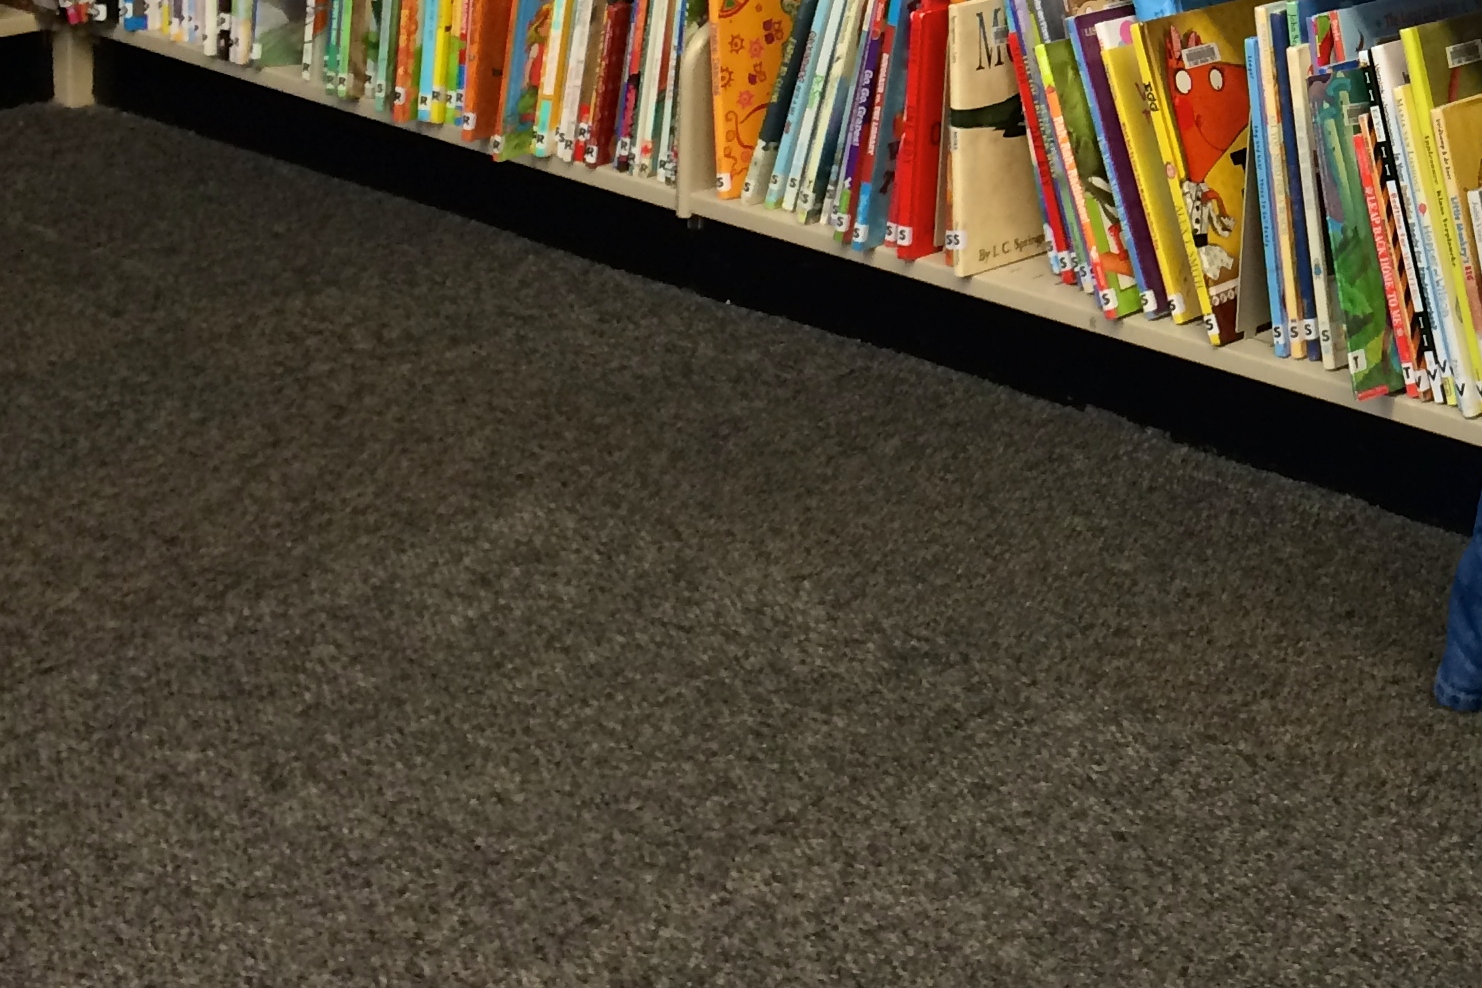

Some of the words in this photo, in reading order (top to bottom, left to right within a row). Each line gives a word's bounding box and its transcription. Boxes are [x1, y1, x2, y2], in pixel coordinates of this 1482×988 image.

[1144, 82, 1159, 113] EGG
[1365, 195, 1381, 225] LEAP
[1370, 226, 1387, 254] BACK
[1377, 257, 1393, 289] HOME
[1389, 305, 1403, 326] ME
[1352, 356, 1360, 368] T
